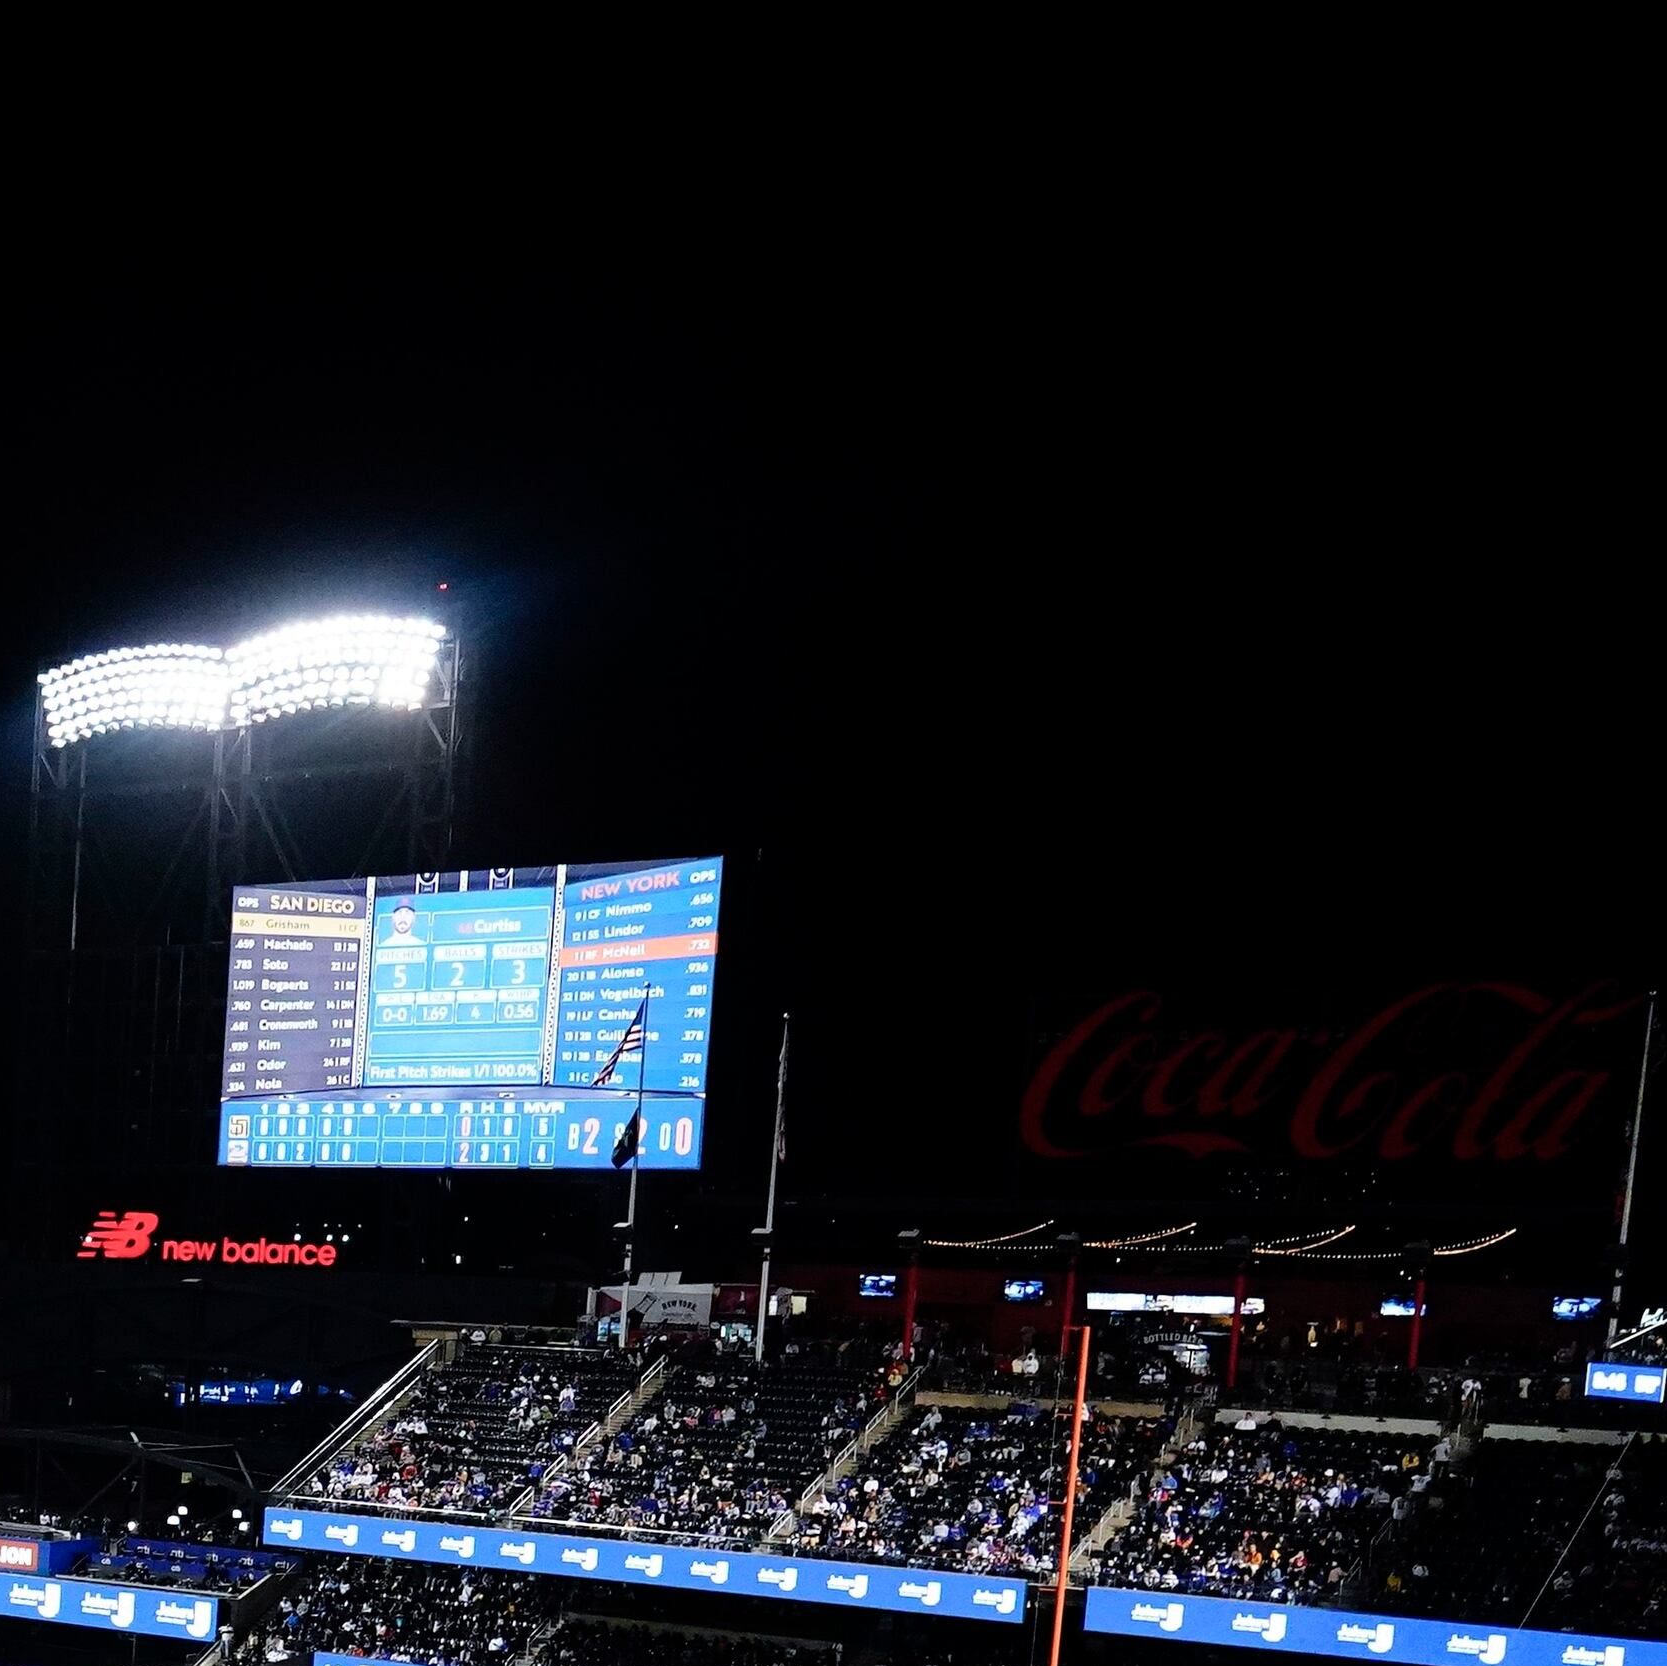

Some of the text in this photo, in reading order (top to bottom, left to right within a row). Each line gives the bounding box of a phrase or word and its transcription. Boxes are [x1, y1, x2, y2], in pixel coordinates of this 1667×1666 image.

[581, 870, 715, 901] NEW YORK OPS
[271, 895, 355, 914] SAN DIEGO
[606, 903, 651, 917] Nimmo
[604, 924, 644, 937] Lindor
[601, 968, 644, 979] Alonso
[370, 1066, 395, 1078] First
[398, 1066, 428, 1078] Pitch
[431, 1065, 471, 1077] Strikes
[162, 1238, 336, 1266] new balance
